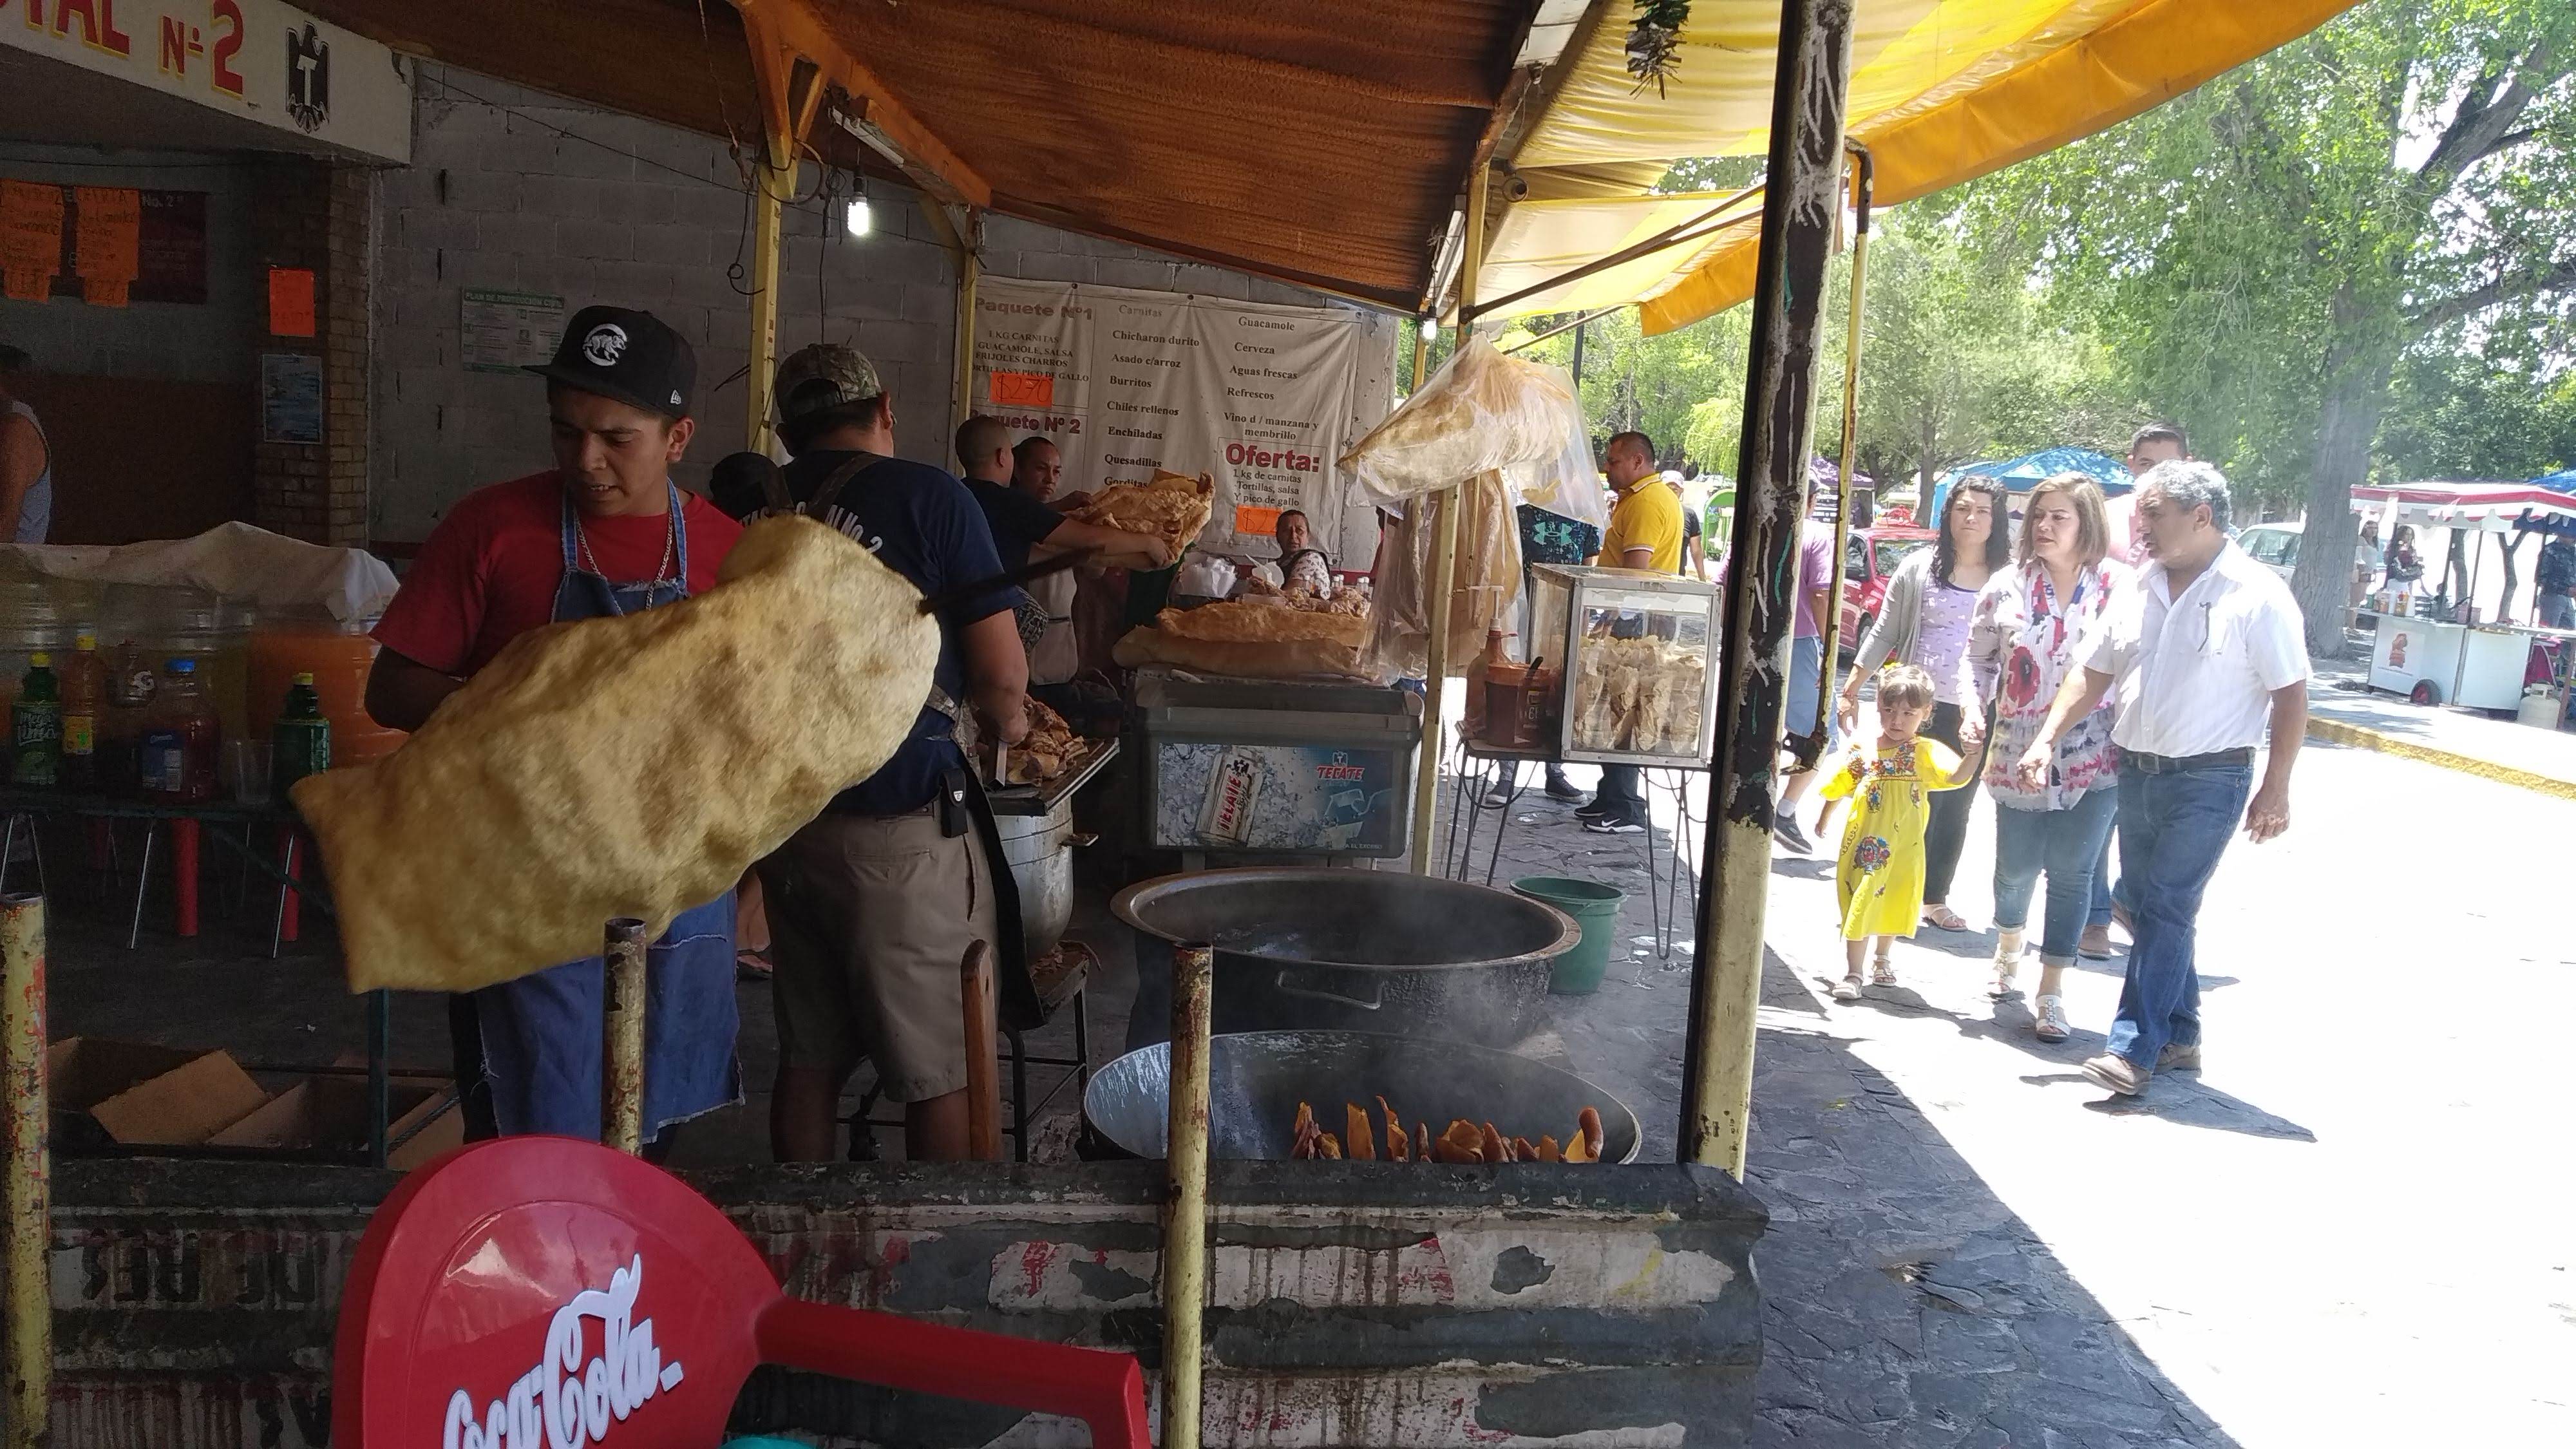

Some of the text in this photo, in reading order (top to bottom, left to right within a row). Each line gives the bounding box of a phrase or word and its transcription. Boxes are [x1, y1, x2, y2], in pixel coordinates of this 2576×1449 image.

[212, 0, 243, 100] 2
[975, 298, 1054, 317] Paquete
[1119, 304, 1162, 317] Carnitas
[1238, 316, 1295, 330] Guacamole
[996, 330, 1009, 339] KG
[1012, 332, 1059, 344] CARNITAS
[1112, 330, 1200, 346] Chicharon durito
[1044, 348, 1074, 357] SALSA
[1234, 342, 1275, 354] Cerveza
[976, 352, 1068, 367] FRIJOLES CHARROS
[1111, 354, 1181, 368] Asado c/arroz
[972, 365, 1013, 374] RTILLAS
[1058, 373, 1090, 382] GALLO
[1229, 365, 1298, 379] Aguas frescas
[996, 374, 1053, 402] $270
[1110, 375, 1152, 388] Burritos
[1227, 387, 1275, 400] Refrescos
[1107, 401, 1179, 416] Chiles rellenos
[1069, 419, 1081, 434] 2
[1224, 412, 1247, 422] Vino
[1265, 418, 1310, 429] manzana
[1312, 422, 1319, 431] y
[1108, 426, 1163, 440] Enchiladas
[1245, 428, 1296, 440] membrillo
[1104, 454, 1162, 468] Quesadillas
[1226, 443, 1320, 473] Oferta:
[1104, 477, 1148, 488] Gorditas
[1240, 469, 1252, 480] kg
[1255, 471, 1265, 480] de
[1267, 473, 1302, 484] carnitas
[1236, 480, 1300, 495] Tortillas, salsa
[1234, 493, 1300, 507] Y pico de gallo
[1243, 509, 1280, 533] $2
[1317, 766, 1365, 781] TECATE
